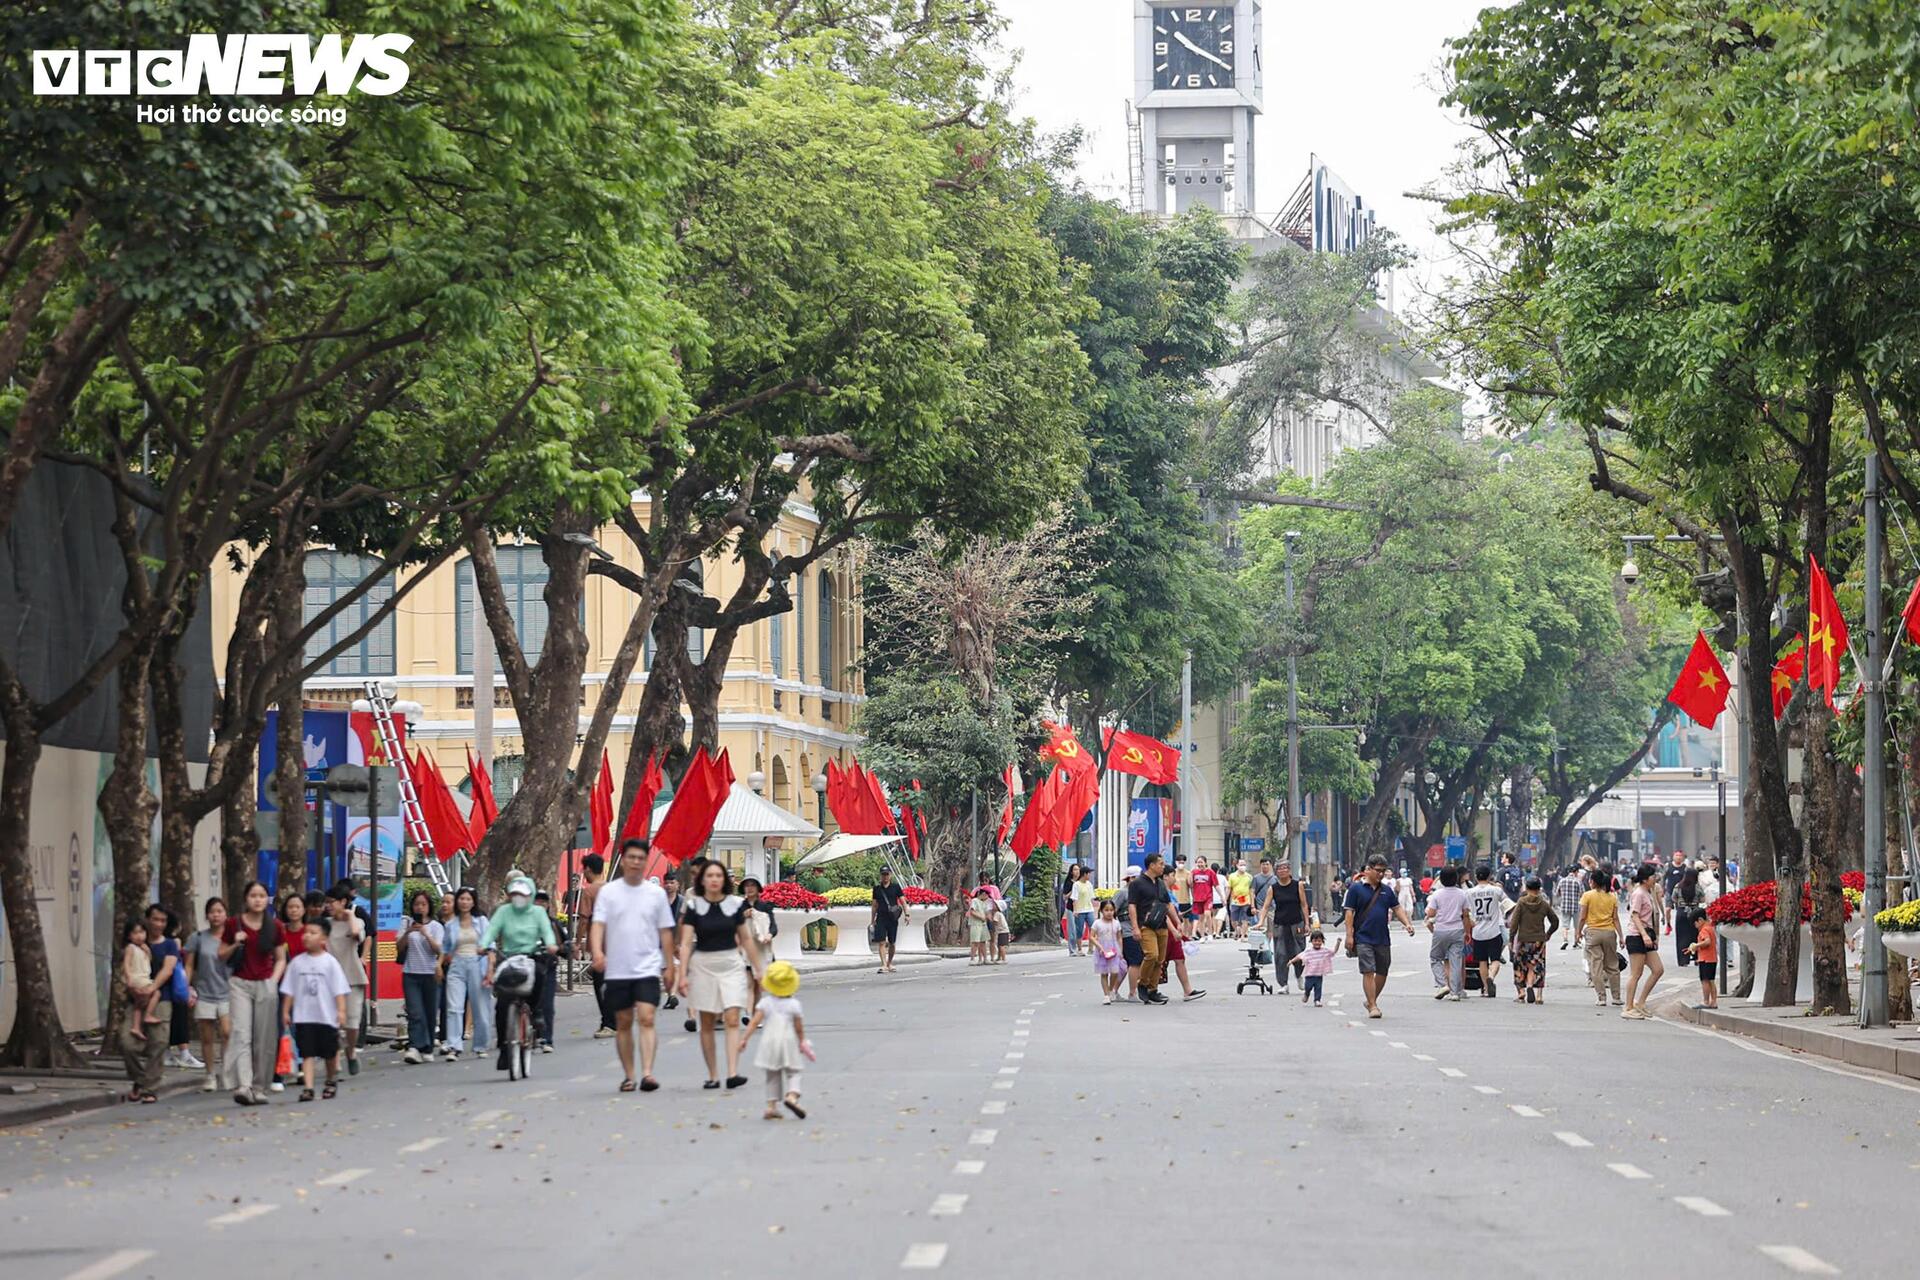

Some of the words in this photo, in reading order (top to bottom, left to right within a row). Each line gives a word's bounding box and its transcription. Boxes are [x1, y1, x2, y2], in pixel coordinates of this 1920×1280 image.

[1186, 9, 1201, 22] 12
[1155, 42, 1168, 55] 9
[1220, 41, 1233, 54] 3
[1187, 74, 1200, 87] 6
[1475, 897, 1493, 915] 27
